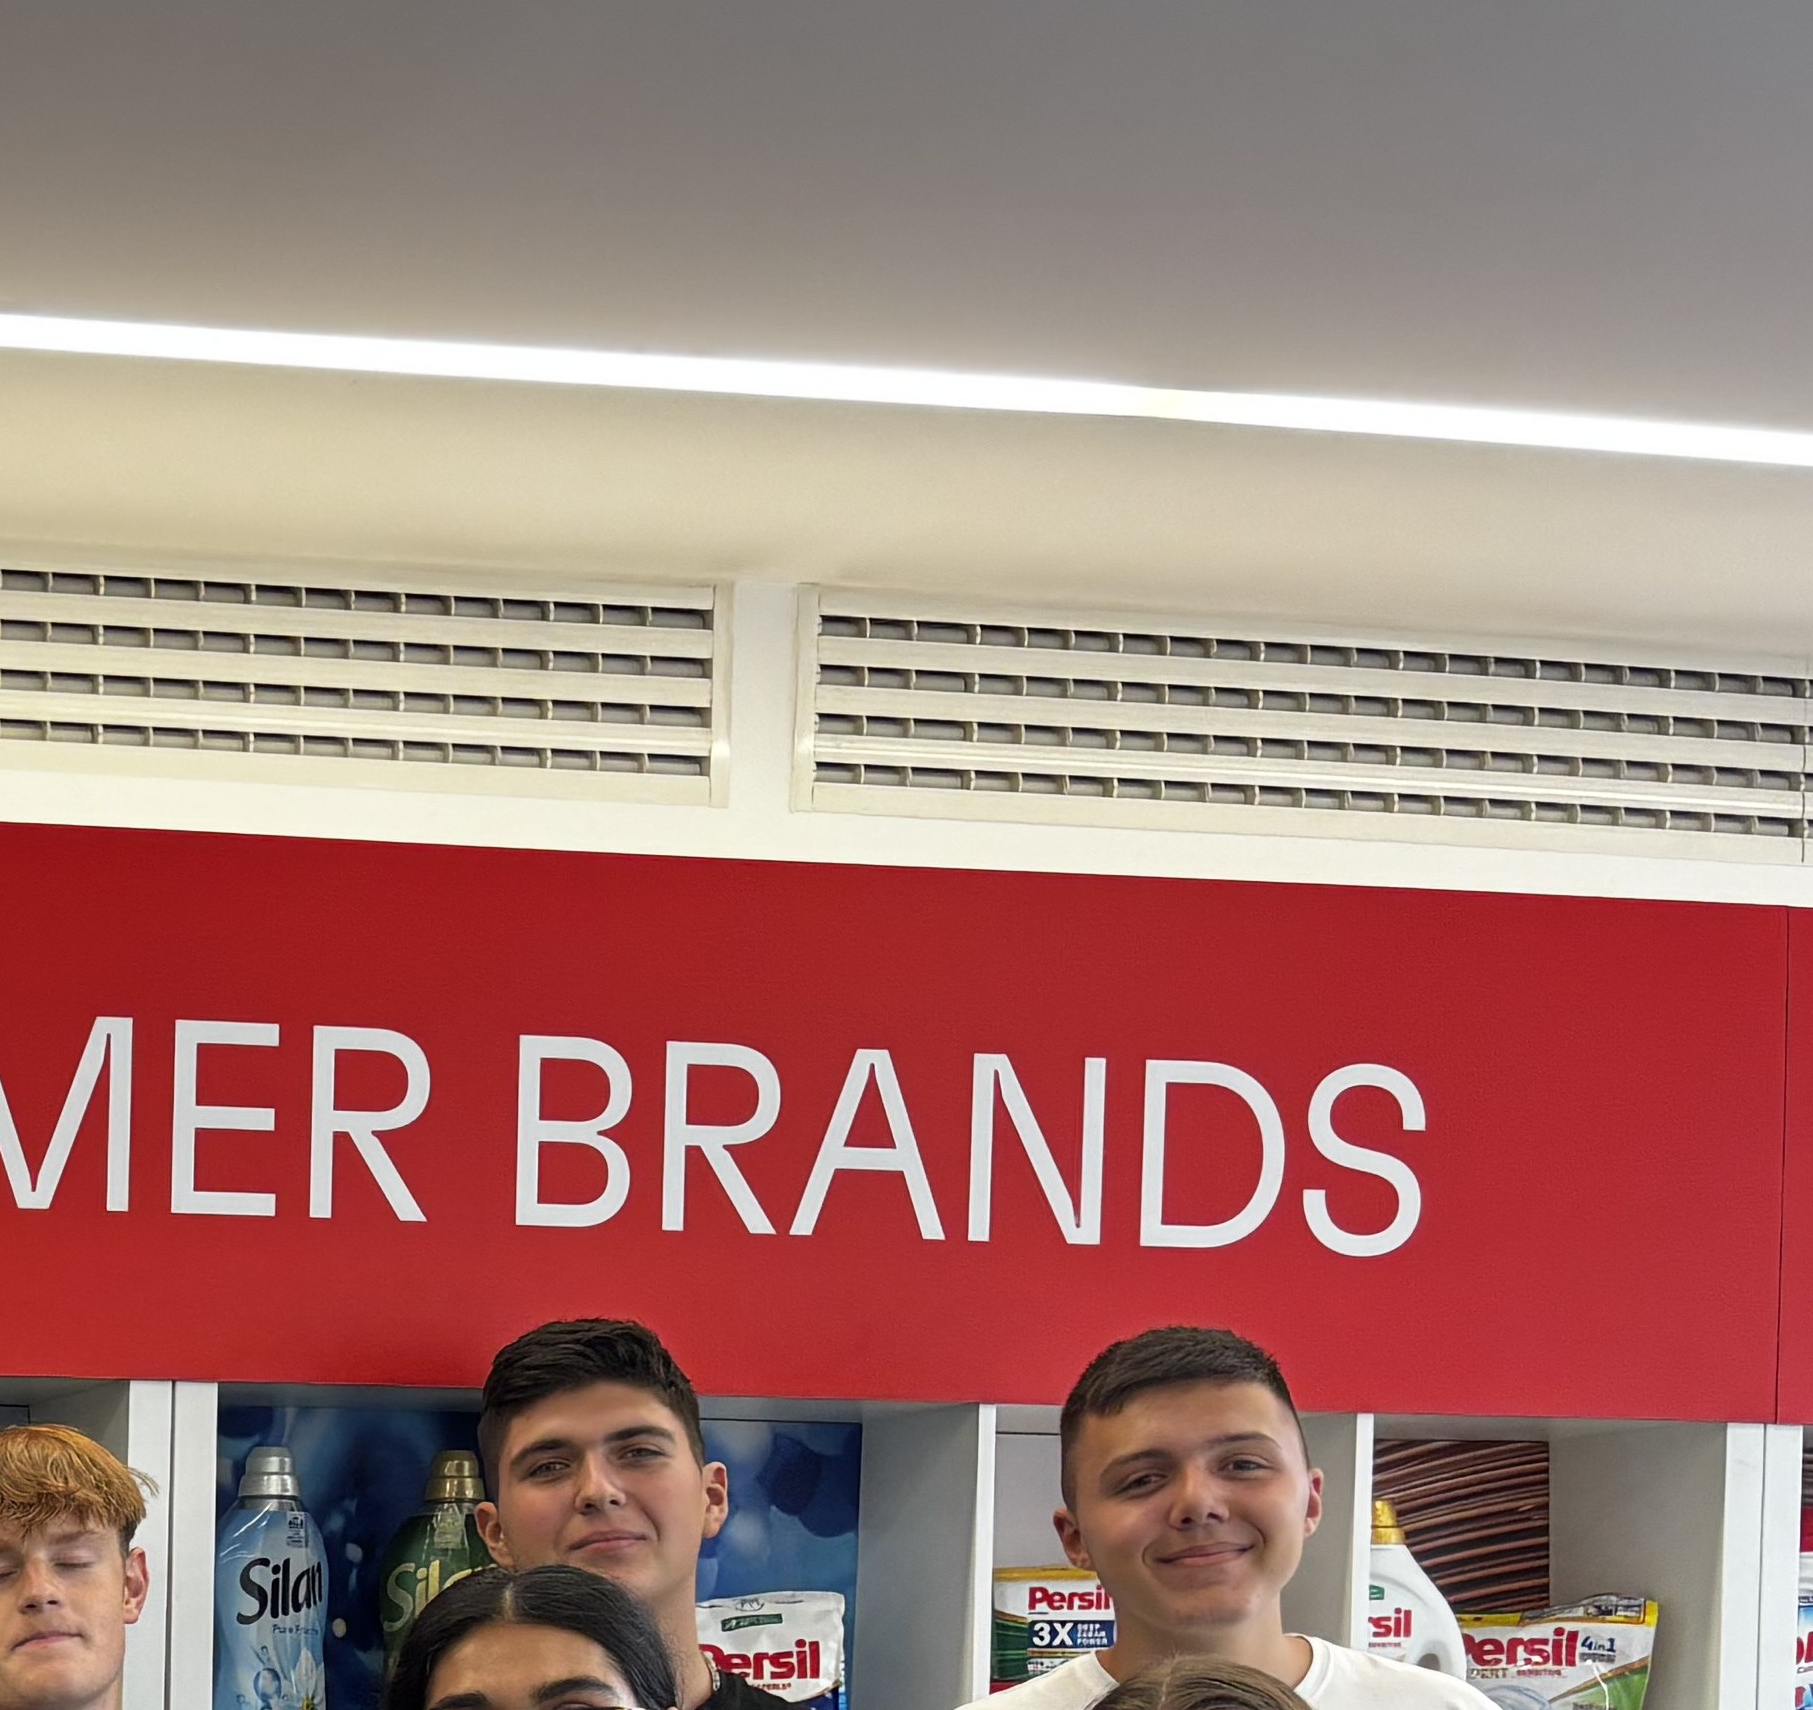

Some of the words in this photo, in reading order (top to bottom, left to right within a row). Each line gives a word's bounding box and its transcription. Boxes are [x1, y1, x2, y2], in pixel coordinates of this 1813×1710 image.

[515, 1034, 1426, 1257] BRANDS
[236, 1557, 323, 1625] Silan
[1032, 1622, 1074, 1647] 3X
